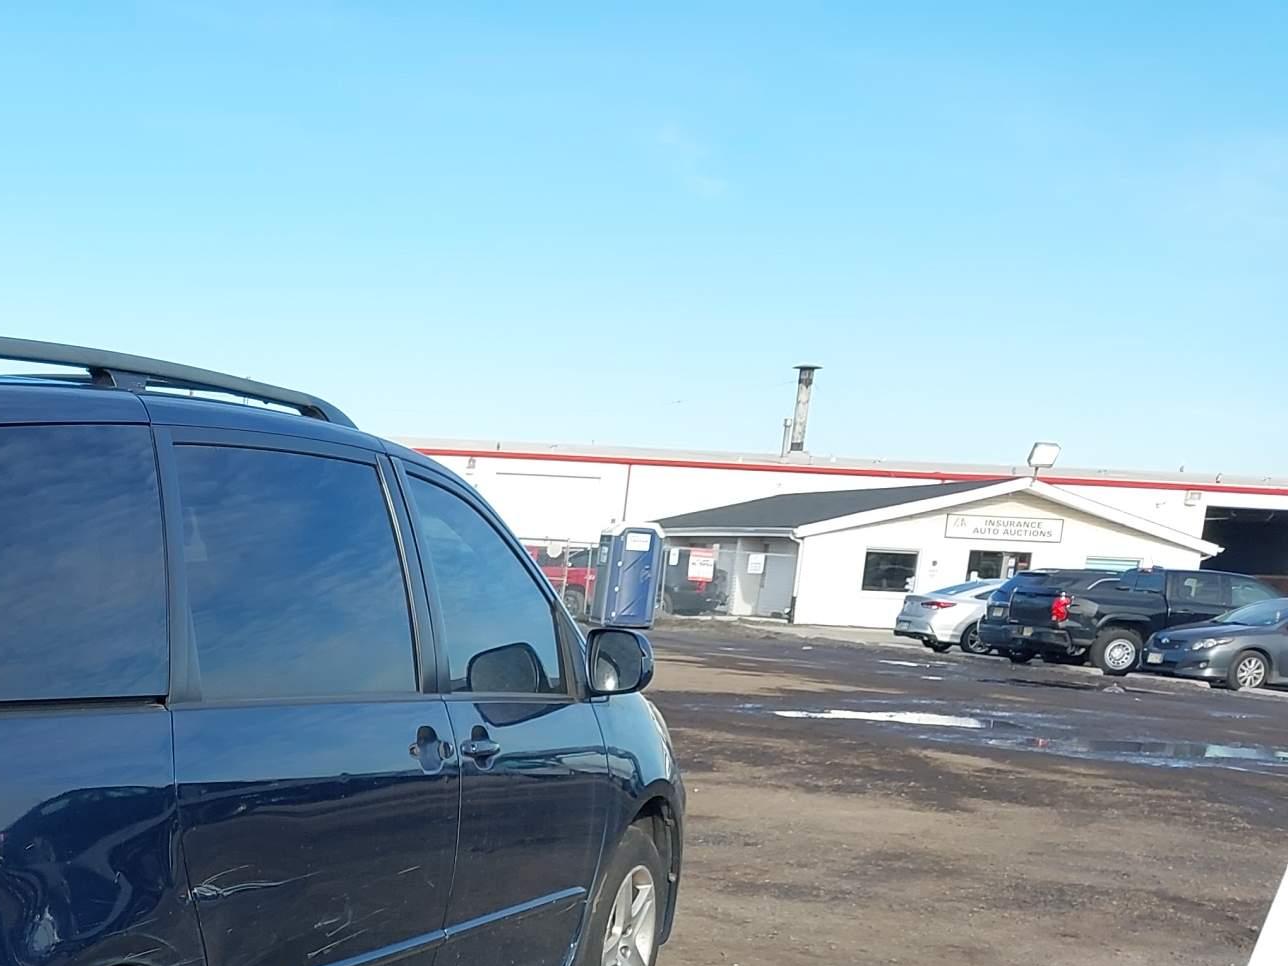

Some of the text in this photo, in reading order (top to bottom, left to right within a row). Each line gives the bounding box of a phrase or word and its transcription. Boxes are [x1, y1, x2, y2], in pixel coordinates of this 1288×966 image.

[984, 519, 1043, 529] INSURANCE
[972, 527, 1053, 537] AUTO AUCTIONS
